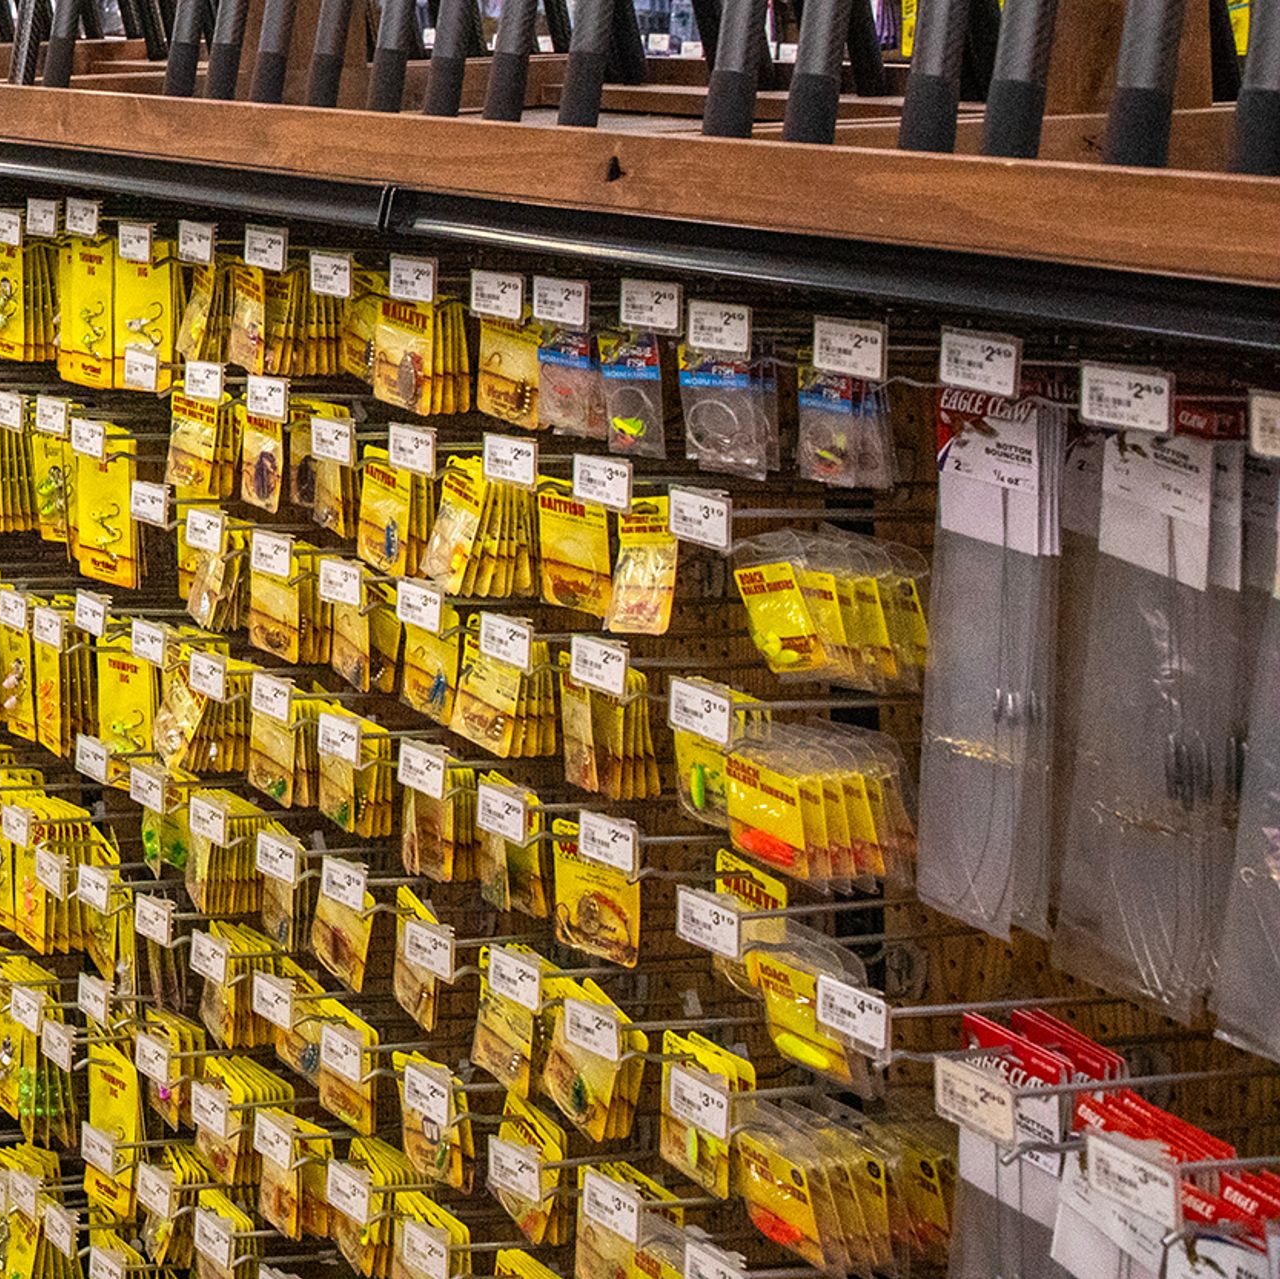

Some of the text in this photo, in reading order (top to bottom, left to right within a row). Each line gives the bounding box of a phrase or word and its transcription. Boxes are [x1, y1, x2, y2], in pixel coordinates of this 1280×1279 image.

[940, 388, 986, 416] EAGLE
[541, 494, 586, 518] BAITFISH
[1223, 1185, 1258, 1216] EAGLE
